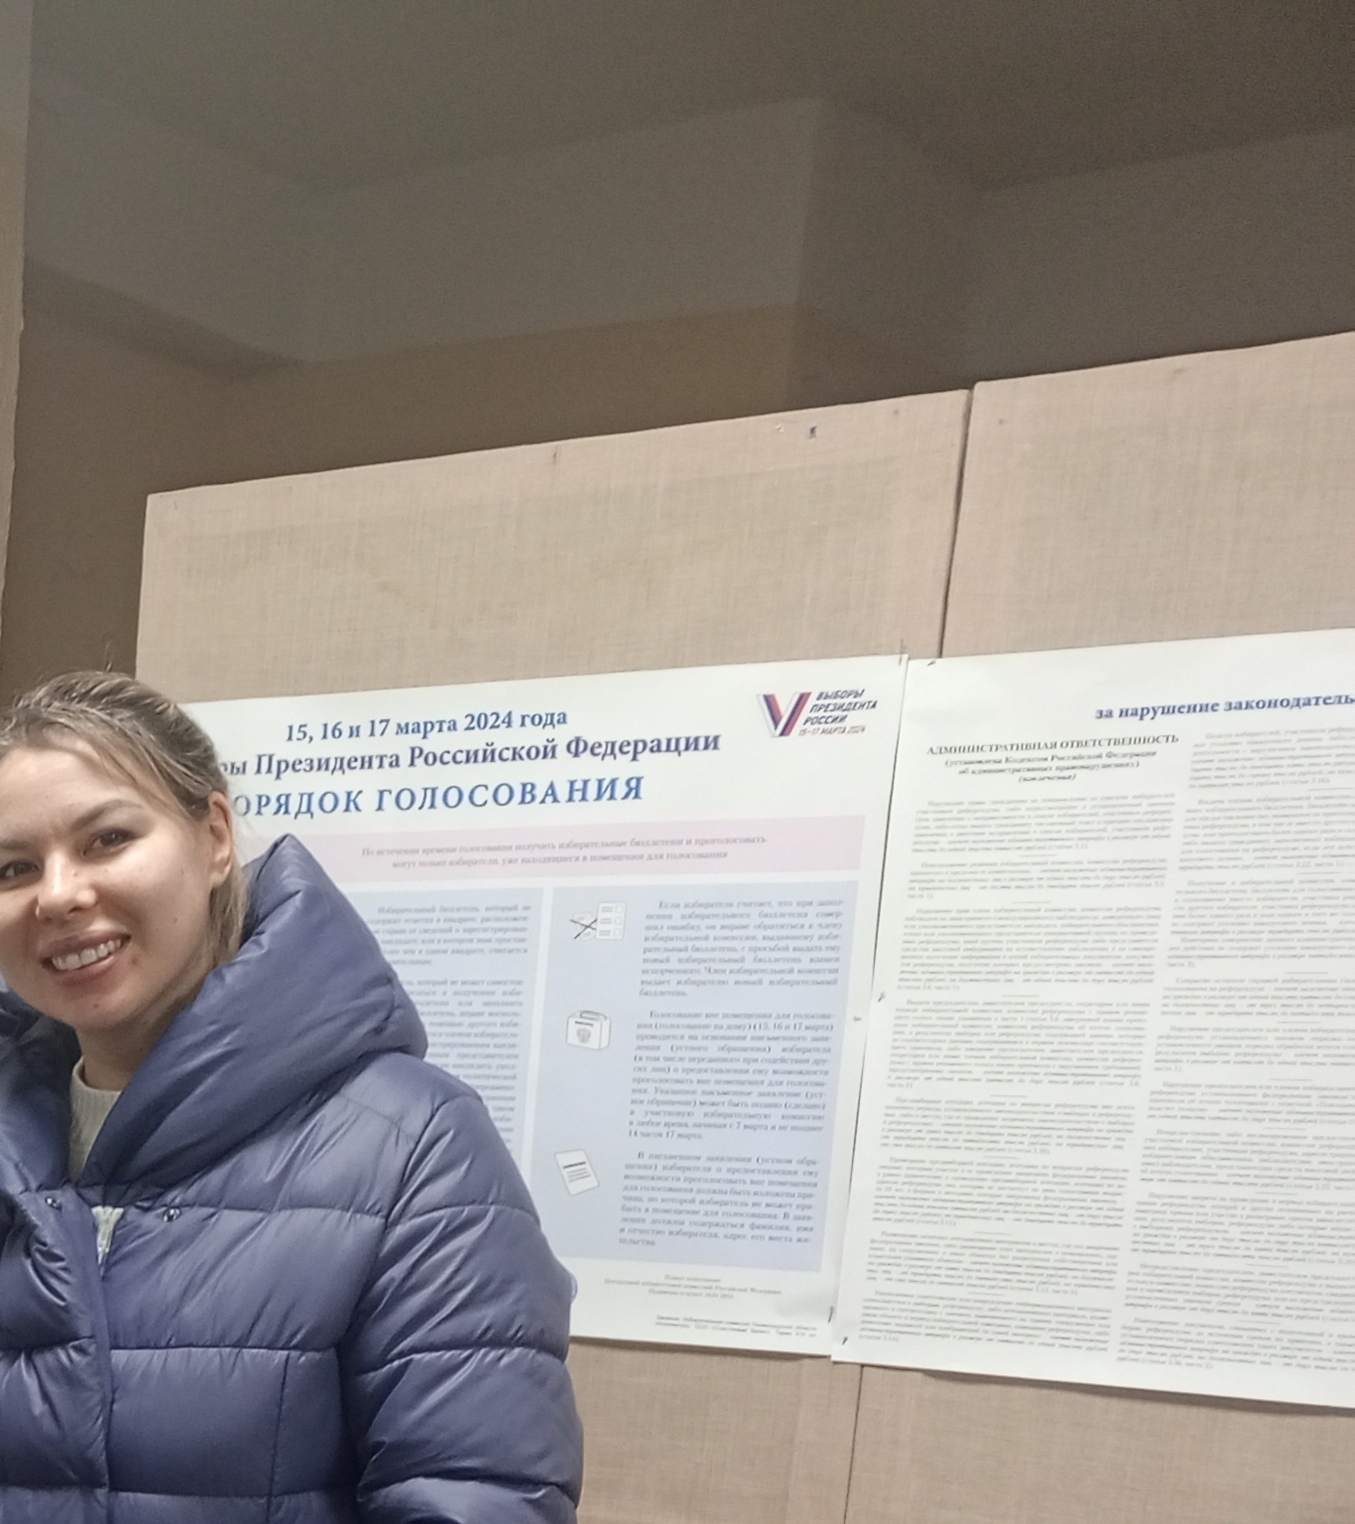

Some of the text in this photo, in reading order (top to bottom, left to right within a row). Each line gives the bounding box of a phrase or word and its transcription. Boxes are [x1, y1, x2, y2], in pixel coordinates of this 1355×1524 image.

[816, 688, 865, 701] ВЫБОРЫ
[809, 699, 878, 713] ПРЕЗИДЕНТА
[1095, 706, 1114, 720] за
[1118, 700, 1220, 722] нарушение
[286, 710, 568, 744] 15, 16 и 17 марта 2024 года
[802, 714, 848, 726] РОССИИ
[254, 752, 400, 780] Президента
[408, 738, 558, 768] Российской
[566, 734, 721, 762] Федерации
[234, 775, 644, 820] ОРЯДОК ГОЛОСОВАНИЯ
